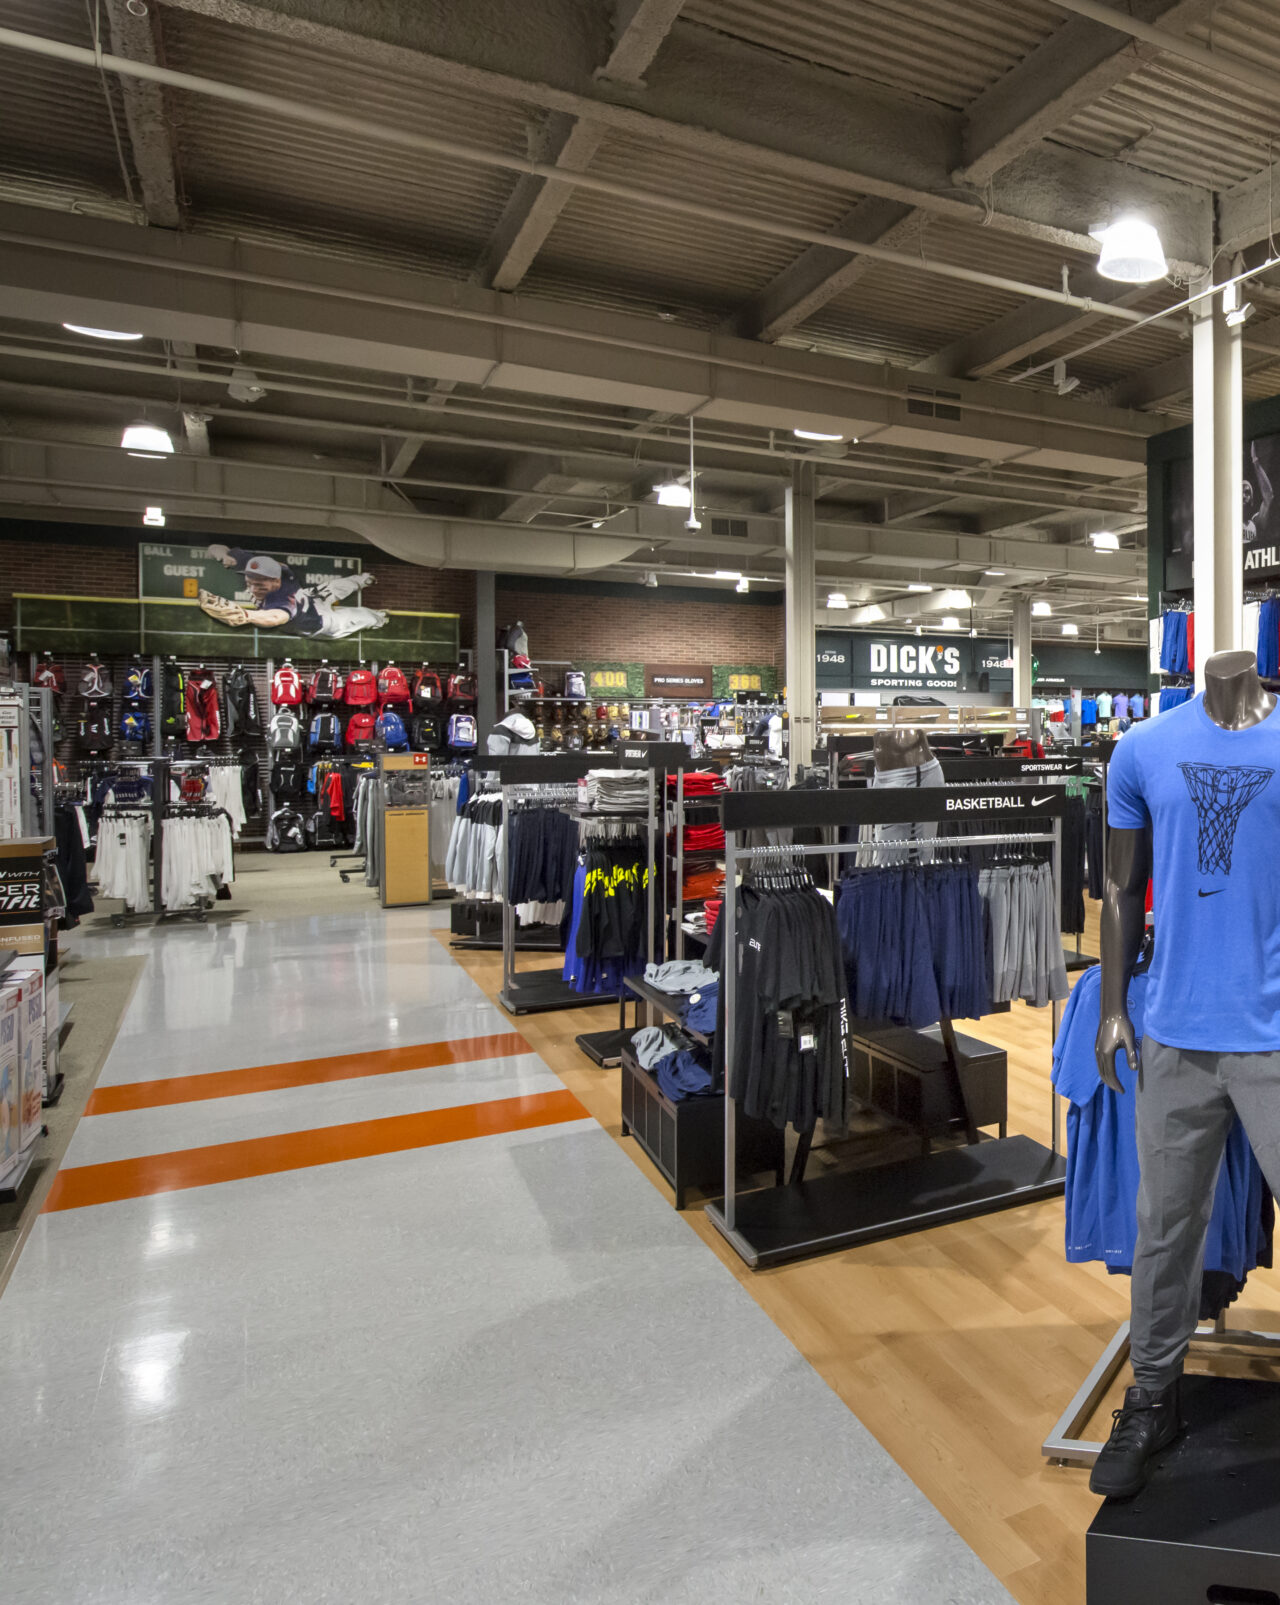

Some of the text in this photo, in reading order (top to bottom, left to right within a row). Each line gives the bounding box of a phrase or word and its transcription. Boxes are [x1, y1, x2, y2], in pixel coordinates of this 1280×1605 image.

[143, 546, 173, 557] BALL
[287, 556, 309, 566] OUT
[334, 559, 354, 570] H E
[163, 565, 206, 577] GUEST
[816, 654, 846, 663] 1948
[870, 643, 960, 675] DICK'S
[594, 671, 626, 687] 400
[870, 678, 922, 688] SPORTING
[1021, 763, 1063, 772] SPORTSWEAR
[945, 796, 1025, 811] BASKETBALL
[840, 997, 850, 1036] NIKE
